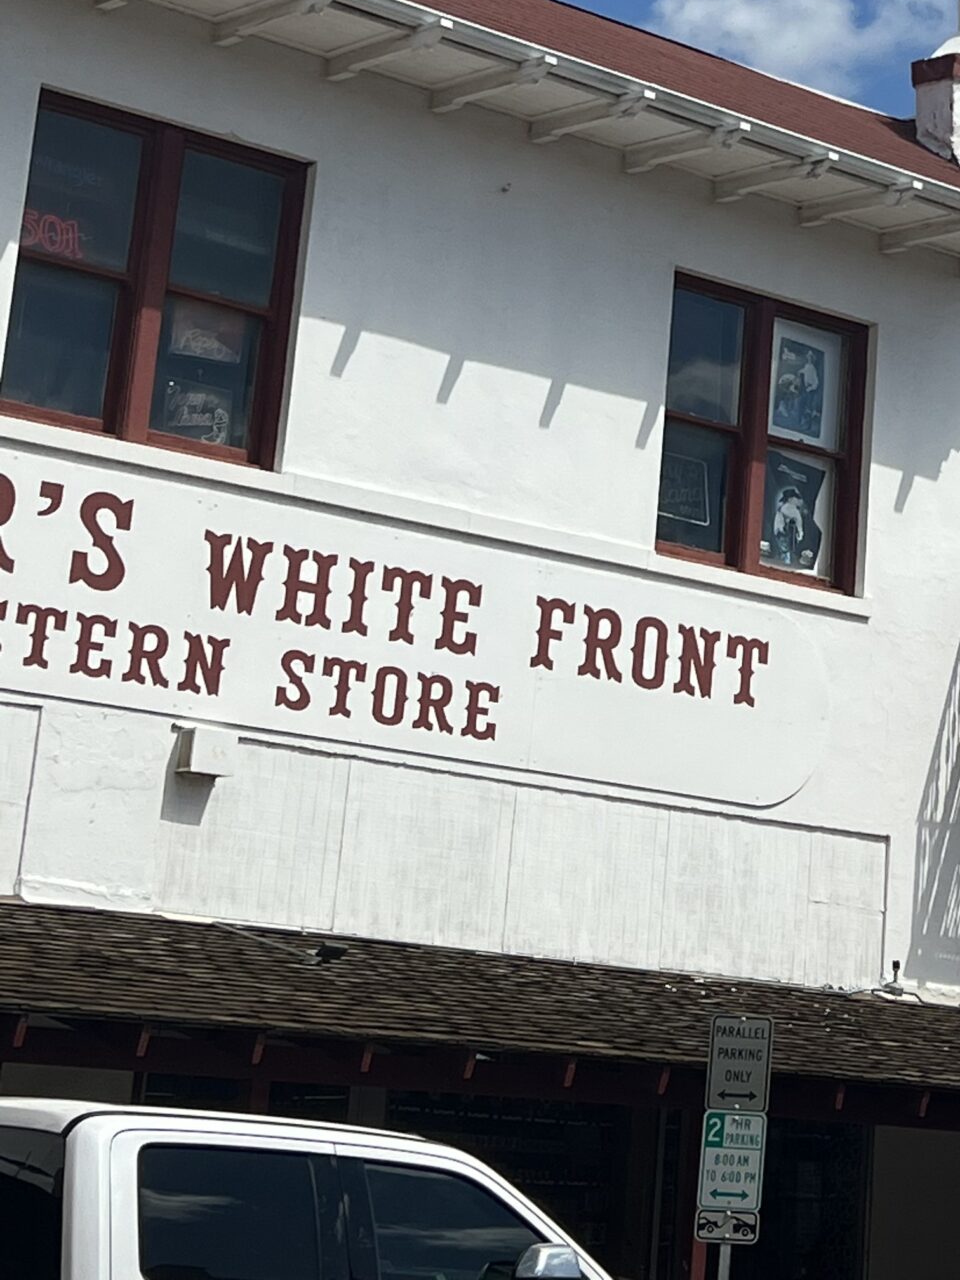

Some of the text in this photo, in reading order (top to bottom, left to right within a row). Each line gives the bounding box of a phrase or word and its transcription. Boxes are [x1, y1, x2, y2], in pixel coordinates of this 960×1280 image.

[0, 473, 769, 708] 'S WHITE FRONT
[0, 600, 500, 741] TERN STORE
[716, 1025, 767, 1040] PARALLEL
[717, 1047, 763, 1062] PARKING
[725, 1069, 752, 1083] ONLY
[707, 1118, 752, 1141] 2 HR
[725, 1133, 761, 1147] PARKING
[736, 1155, 750, 1168] AM
[706, 1168, 717, 1182] TO
[743, 1172, 757, 1184] PM
